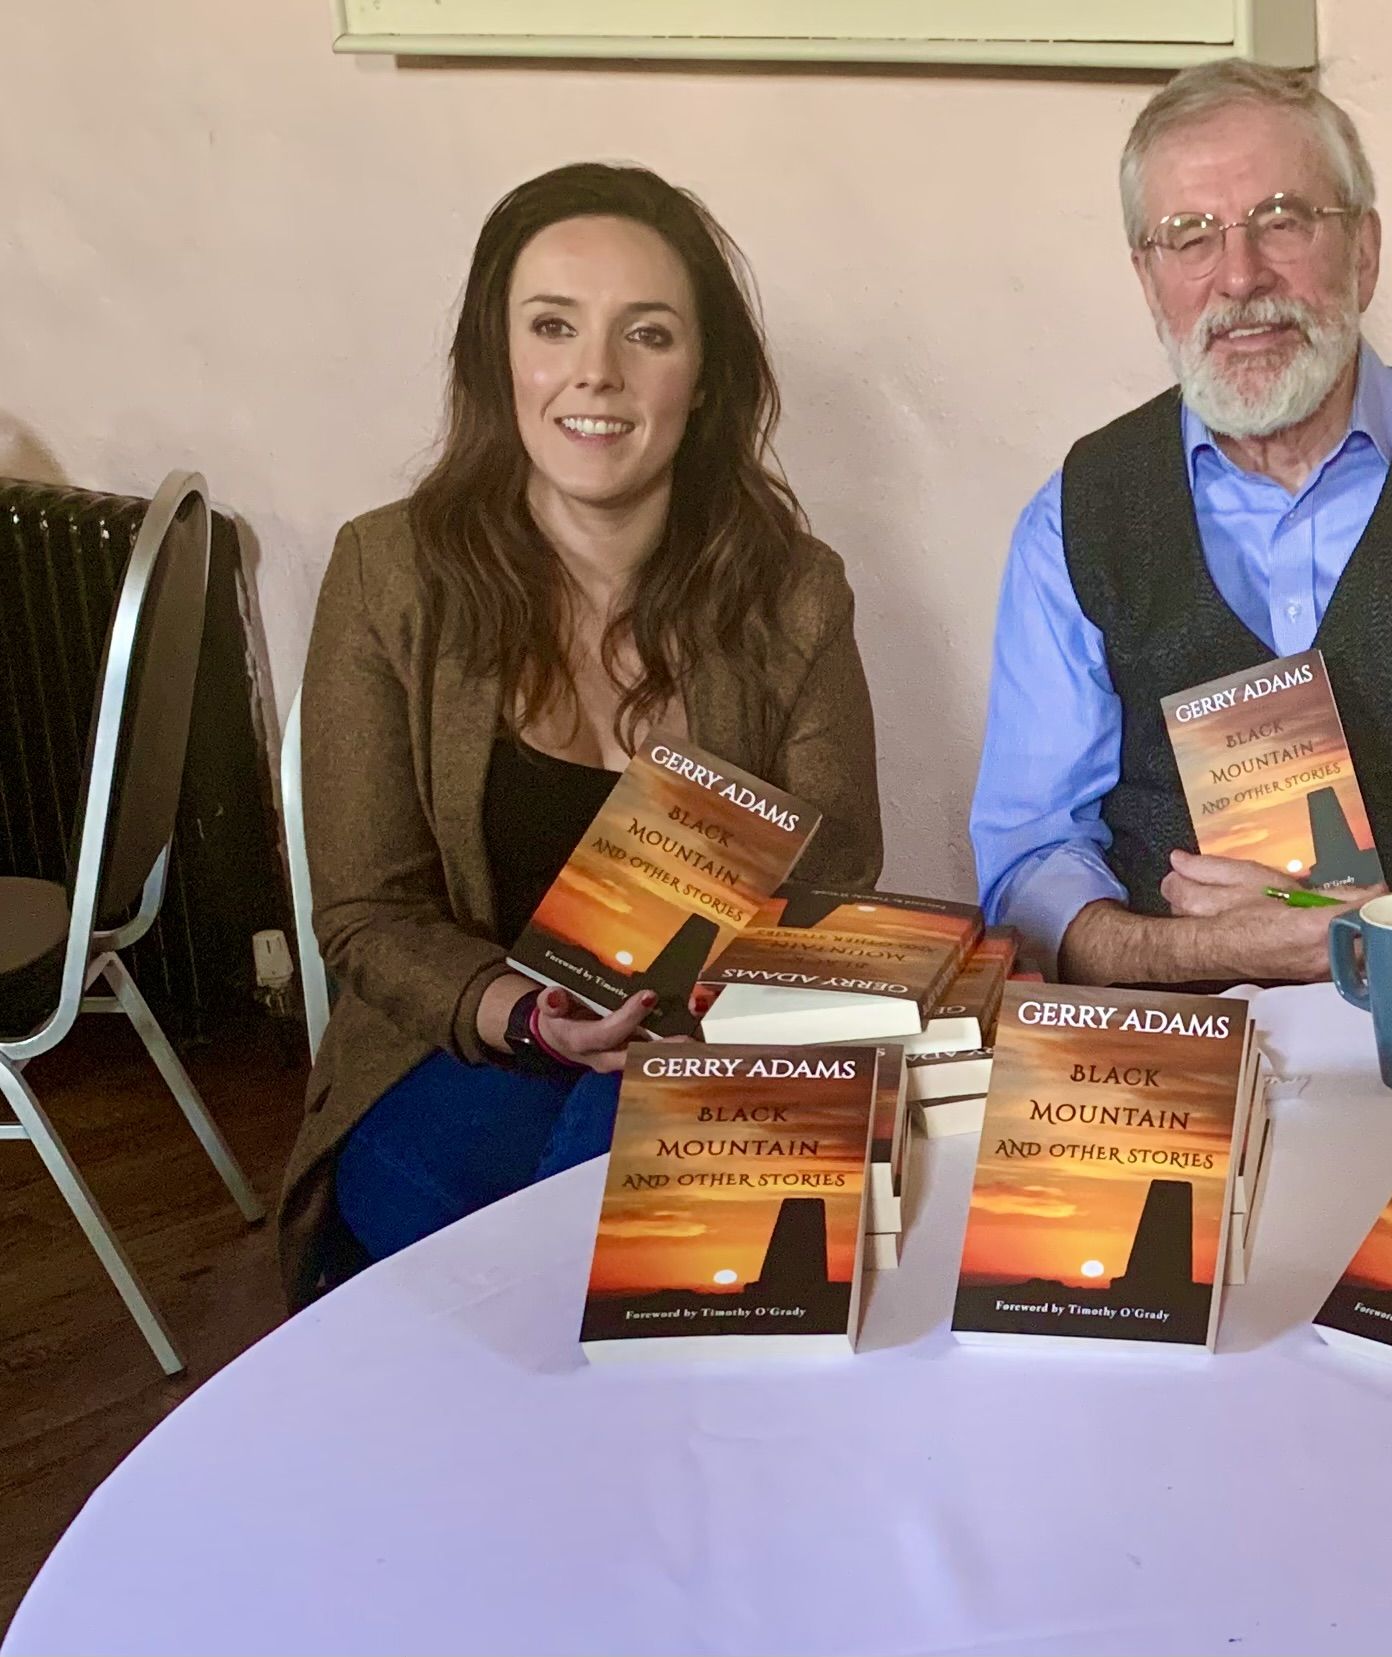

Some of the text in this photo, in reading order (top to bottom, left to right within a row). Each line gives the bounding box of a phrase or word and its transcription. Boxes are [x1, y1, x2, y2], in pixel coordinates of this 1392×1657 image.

[1175, 664, 1313, 723] GERRY ADAMS
[1225, 718, 1284, 748] BLACK
[1208, 741, 1314, 784] MOUNTAIN
[650, 745, 800, 833] GERRY ADAMS
[1201, 762, 1341, 816] AND OTHER STORIES
[668, 805, 736, 848] BLACK
[627, 818, 740, 886] MOUNTAIN
[591, 837, 743, 922] AND OTHER STORIES
[722, 968, 909, 994] GERRY ADAMS
[1018, 1001, 1230, 1039] GERRY ADAMS
[642, 1057, 856, 1079] GERRY ADAMS
[1070, 1064, 1162, 1087] BLACK
[697, 1106, 788, 1122] BLACK
[1030, 1100, 1190, 1130] MOUNTAIN
[656, 1139, 819, 1158] MOUNTAIN
[995, 1139, 1214, 1169] AND OTHER STORIES
[622, 1173, 845, 1190] AND OTHER STORIES
[625, 1307, 806, 1319] Foreword by Timothy O'Grady
[995, 1301, 1170, 1322] Foreword by Timothy O'Grady
